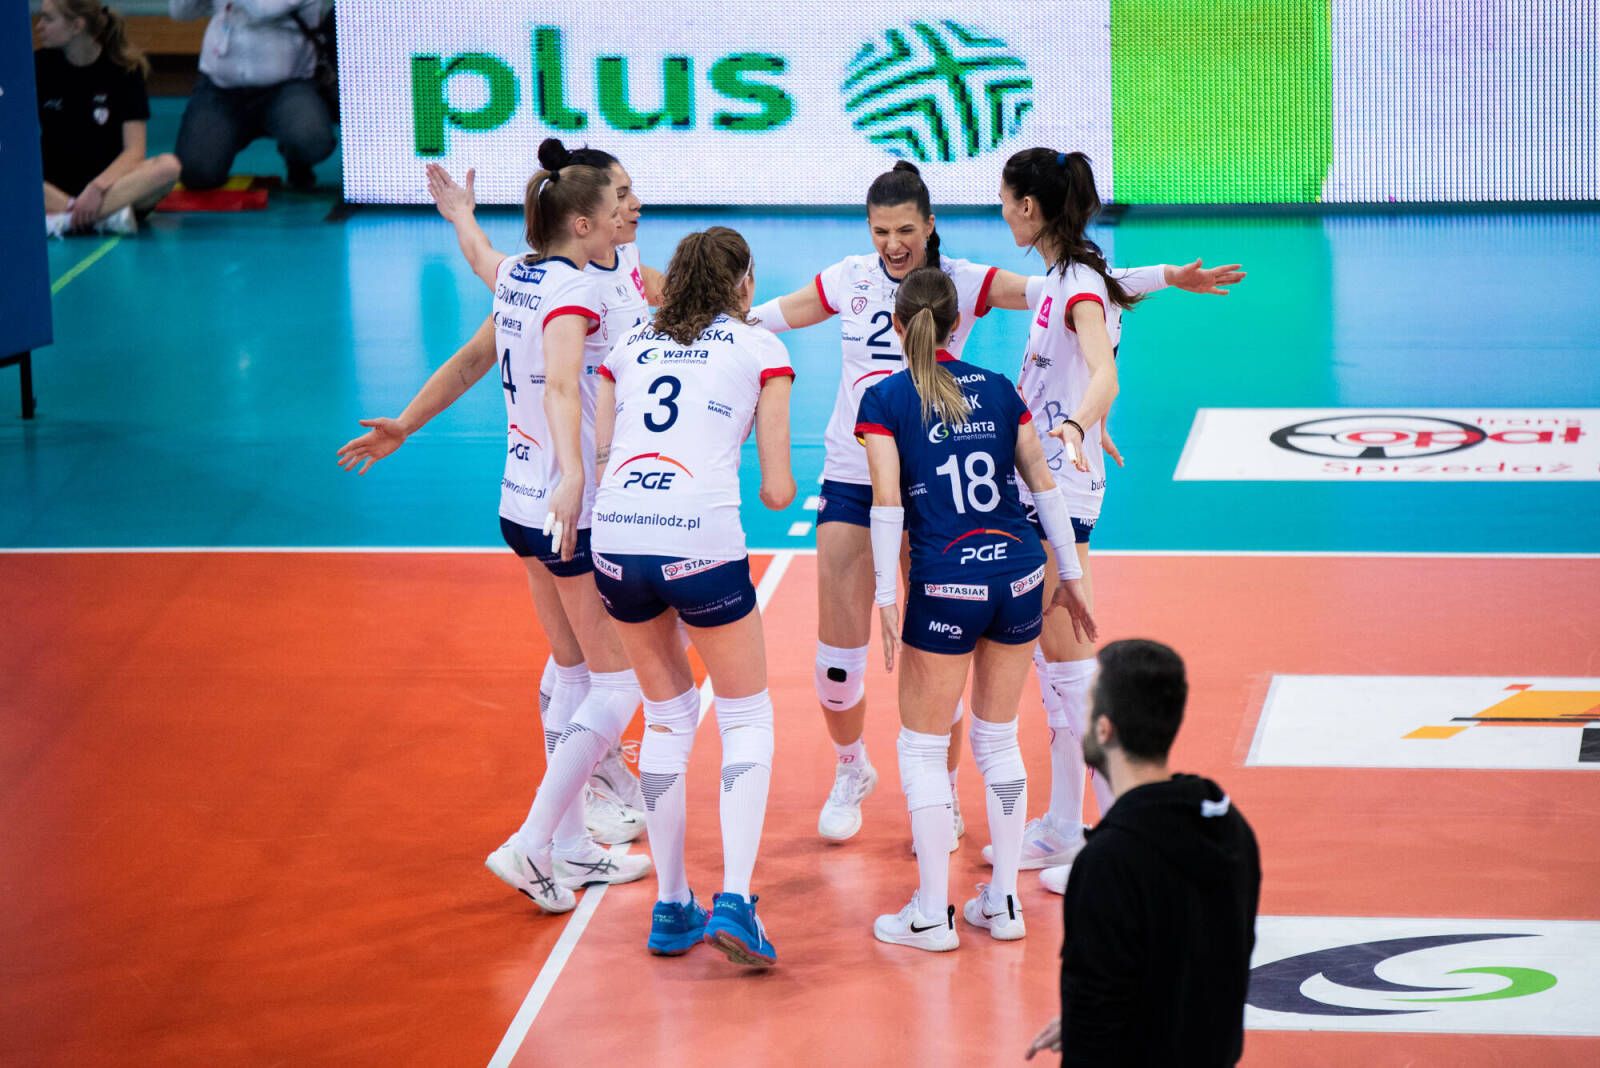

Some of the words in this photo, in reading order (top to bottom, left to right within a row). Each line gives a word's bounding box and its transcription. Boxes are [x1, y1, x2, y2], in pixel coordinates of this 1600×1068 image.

[410, 24, 796, 159] plus
[501, 348, 517, 405] 4
[643, 375, 682, 433] 3
[624, 472, 676, 490] PGE
[936, 451, 1001, 514] 18
[960, 542, 1008, 565] PGE
[942, 586, 985, 597] STASIAK
